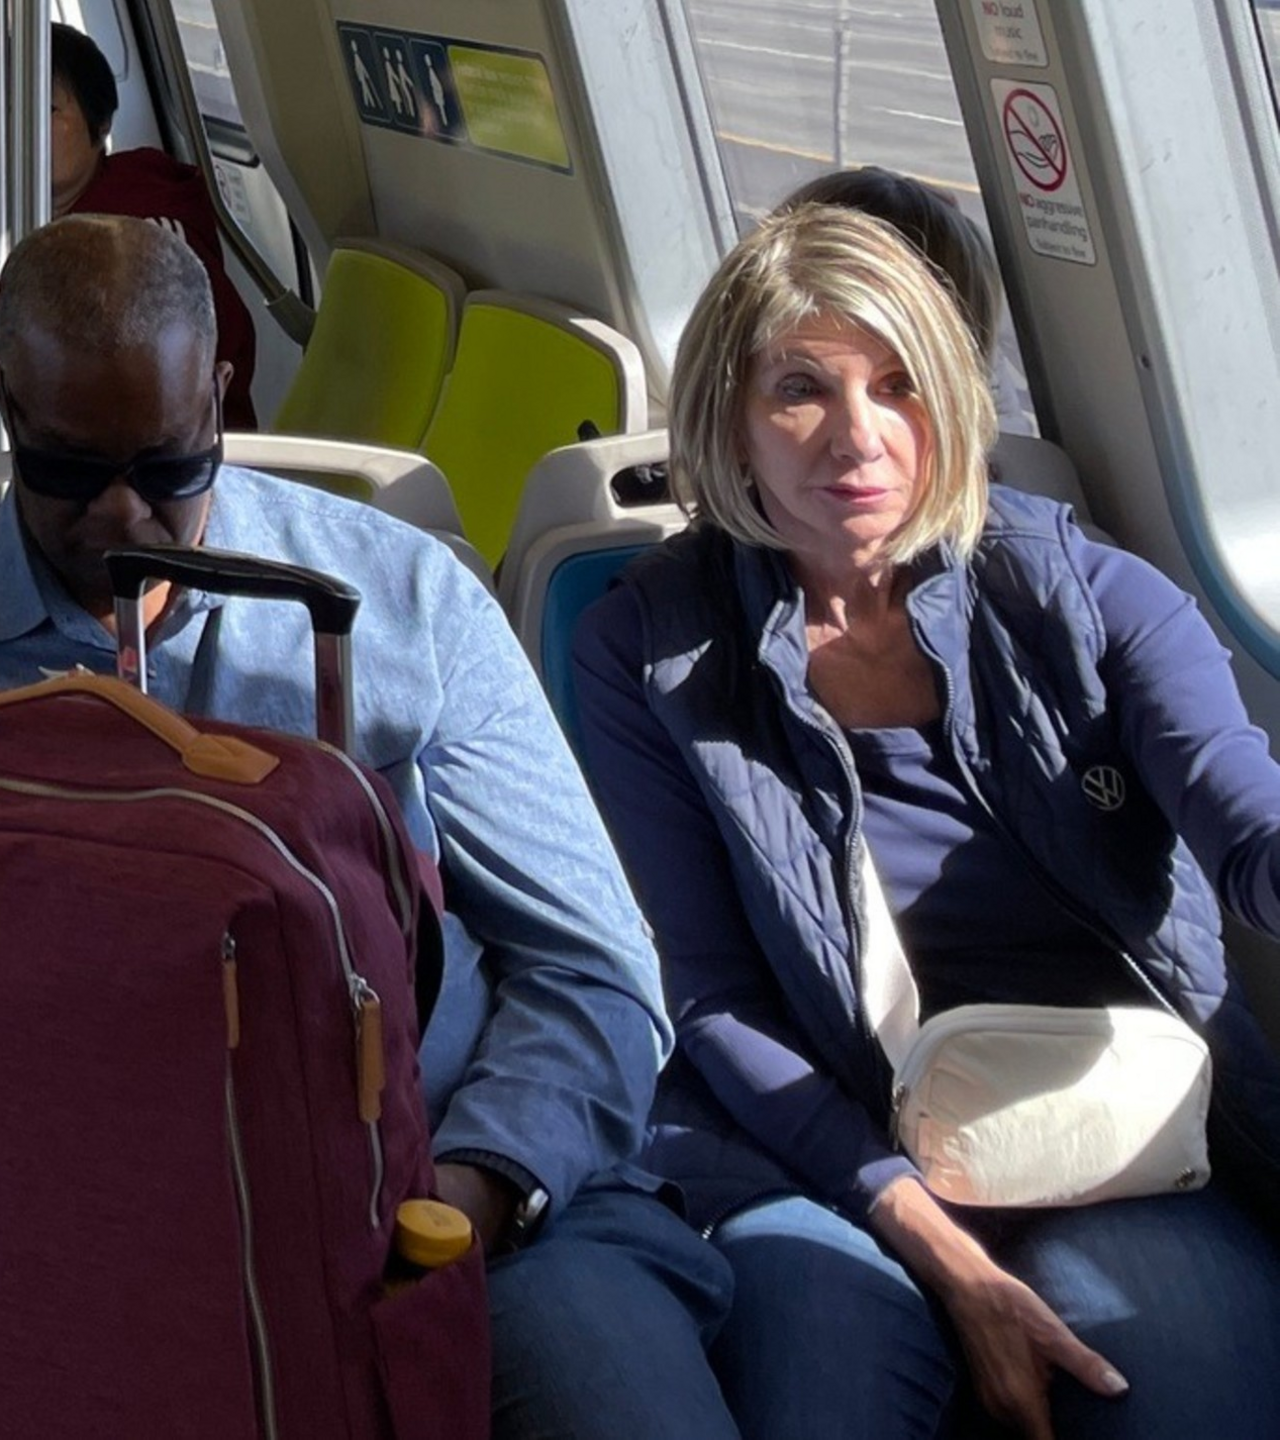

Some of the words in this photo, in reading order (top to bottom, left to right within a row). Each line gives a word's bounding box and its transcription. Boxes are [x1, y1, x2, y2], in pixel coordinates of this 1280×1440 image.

[982, 1, 999, 16] NO
[999, 0, 1025, 19] loud
[1019, 192, 1035, 208] NO
[1036, 198, 1084, 217] aggressive
[1025, 215, 1089, 242] panhandling
